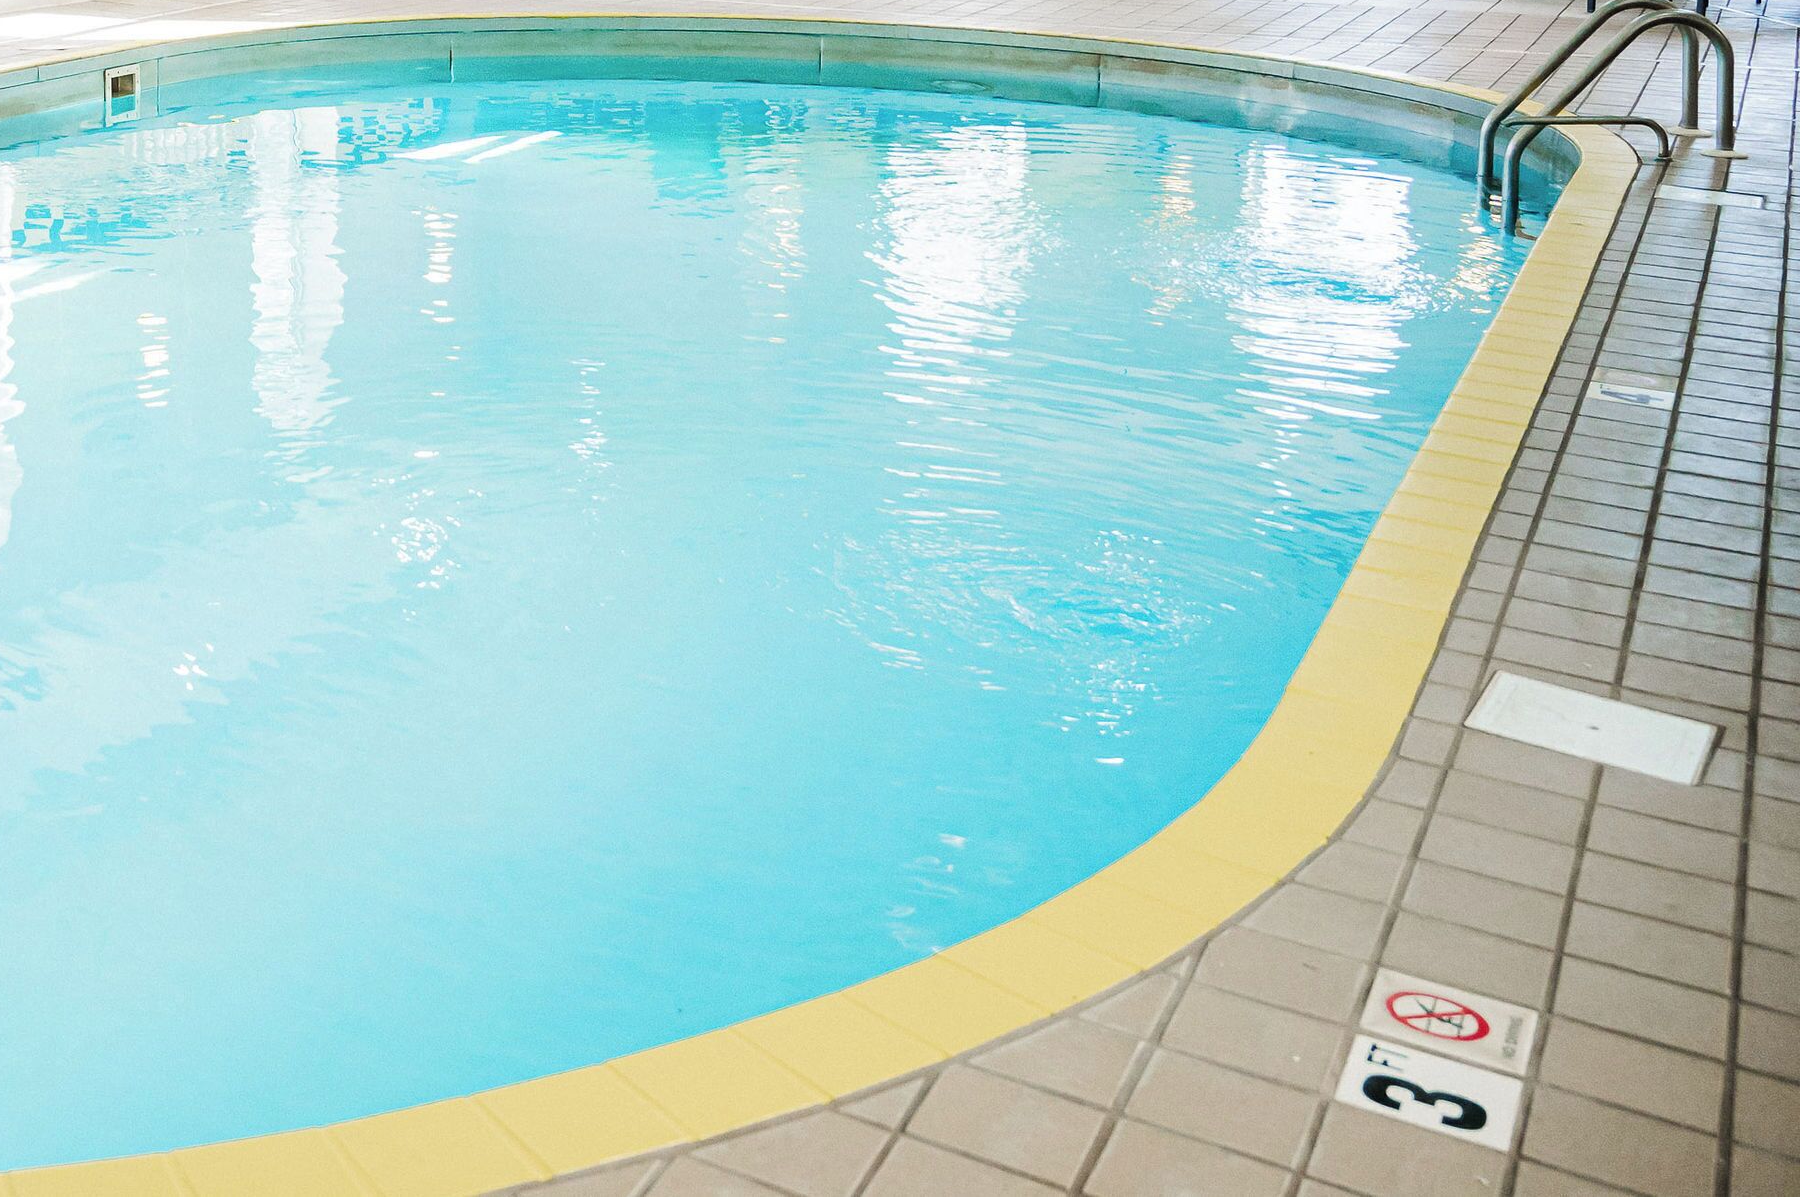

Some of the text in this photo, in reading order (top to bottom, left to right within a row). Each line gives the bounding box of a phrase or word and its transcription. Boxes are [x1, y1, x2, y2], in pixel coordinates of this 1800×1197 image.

[1600, 390, 1664, 404] 4
[1361, 1043, 1487, 1130] 3 FT
